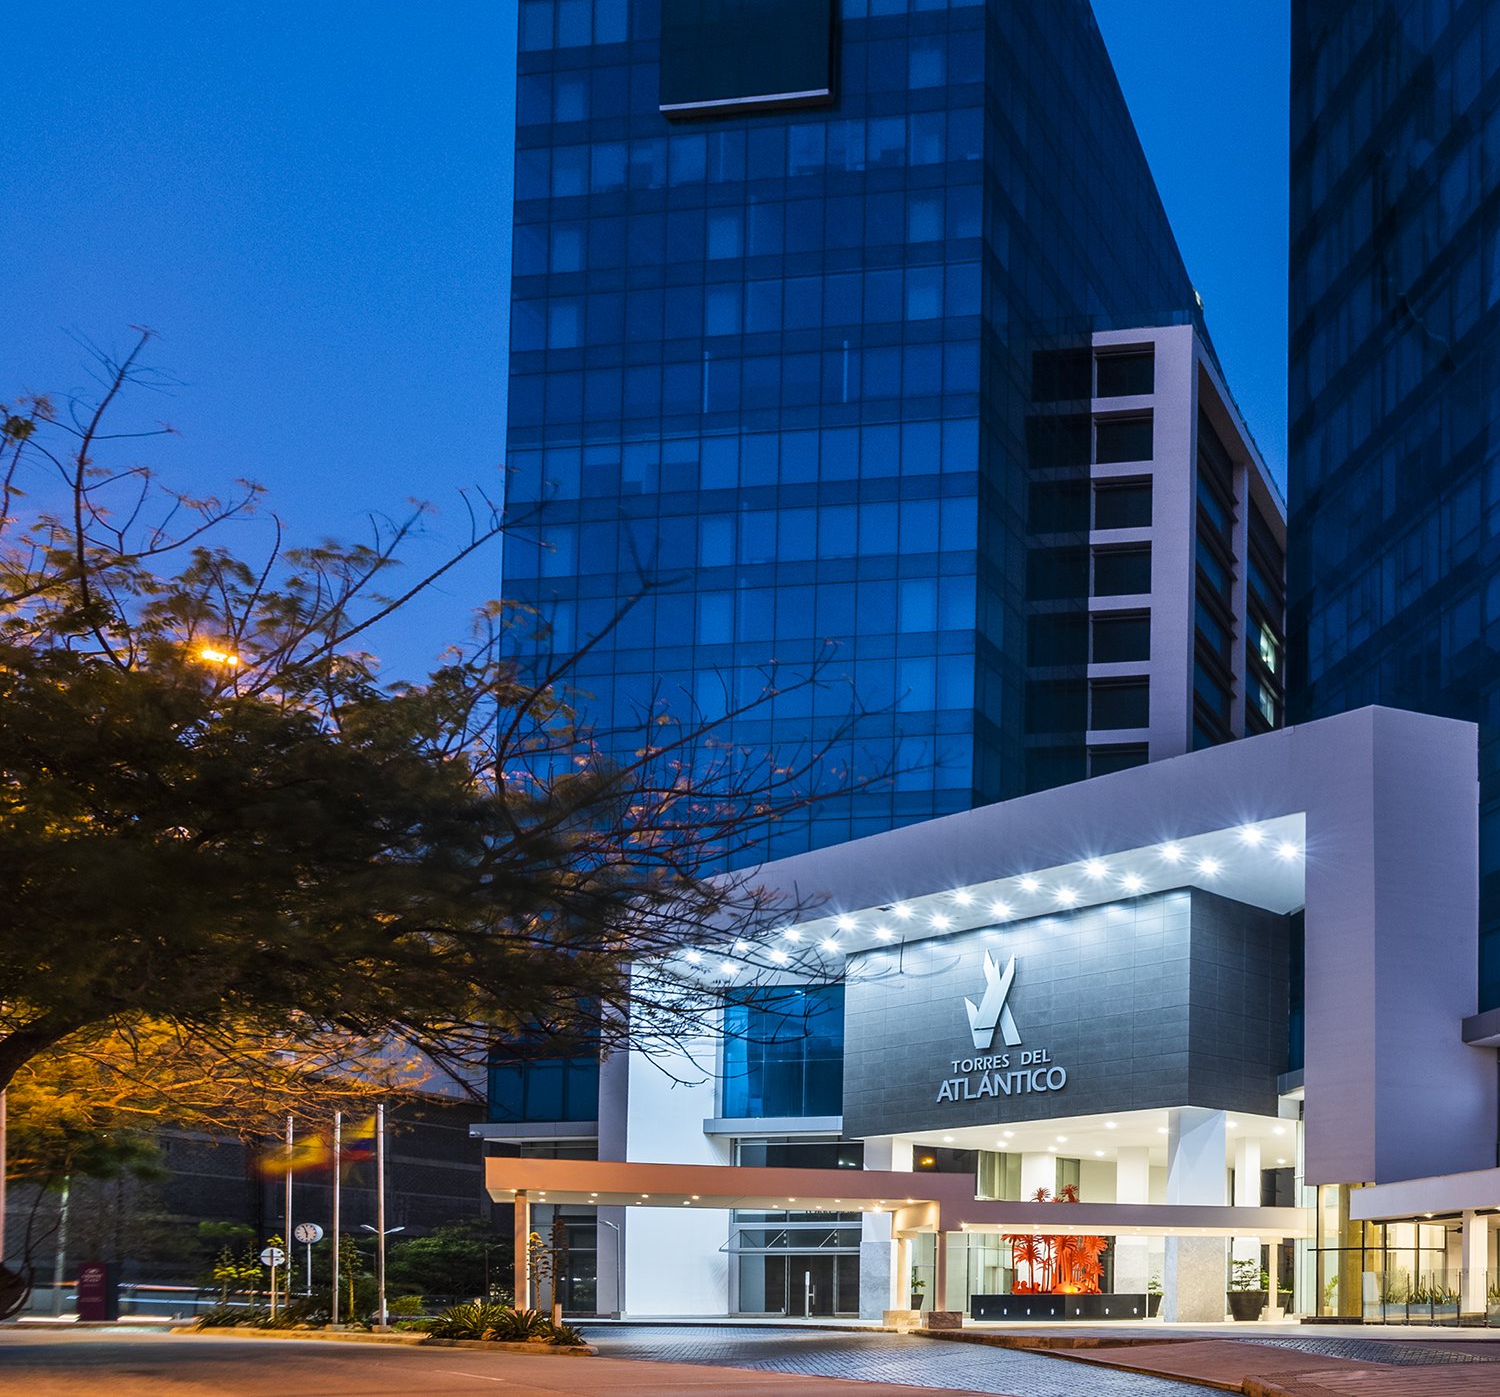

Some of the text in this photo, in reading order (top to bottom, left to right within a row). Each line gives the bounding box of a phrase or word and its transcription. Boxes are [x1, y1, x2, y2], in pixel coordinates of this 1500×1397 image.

[951, 1049, 1051, 1073] TORRES DEL
[936, 1066, 1067, 1103] ATLÁNTICO
